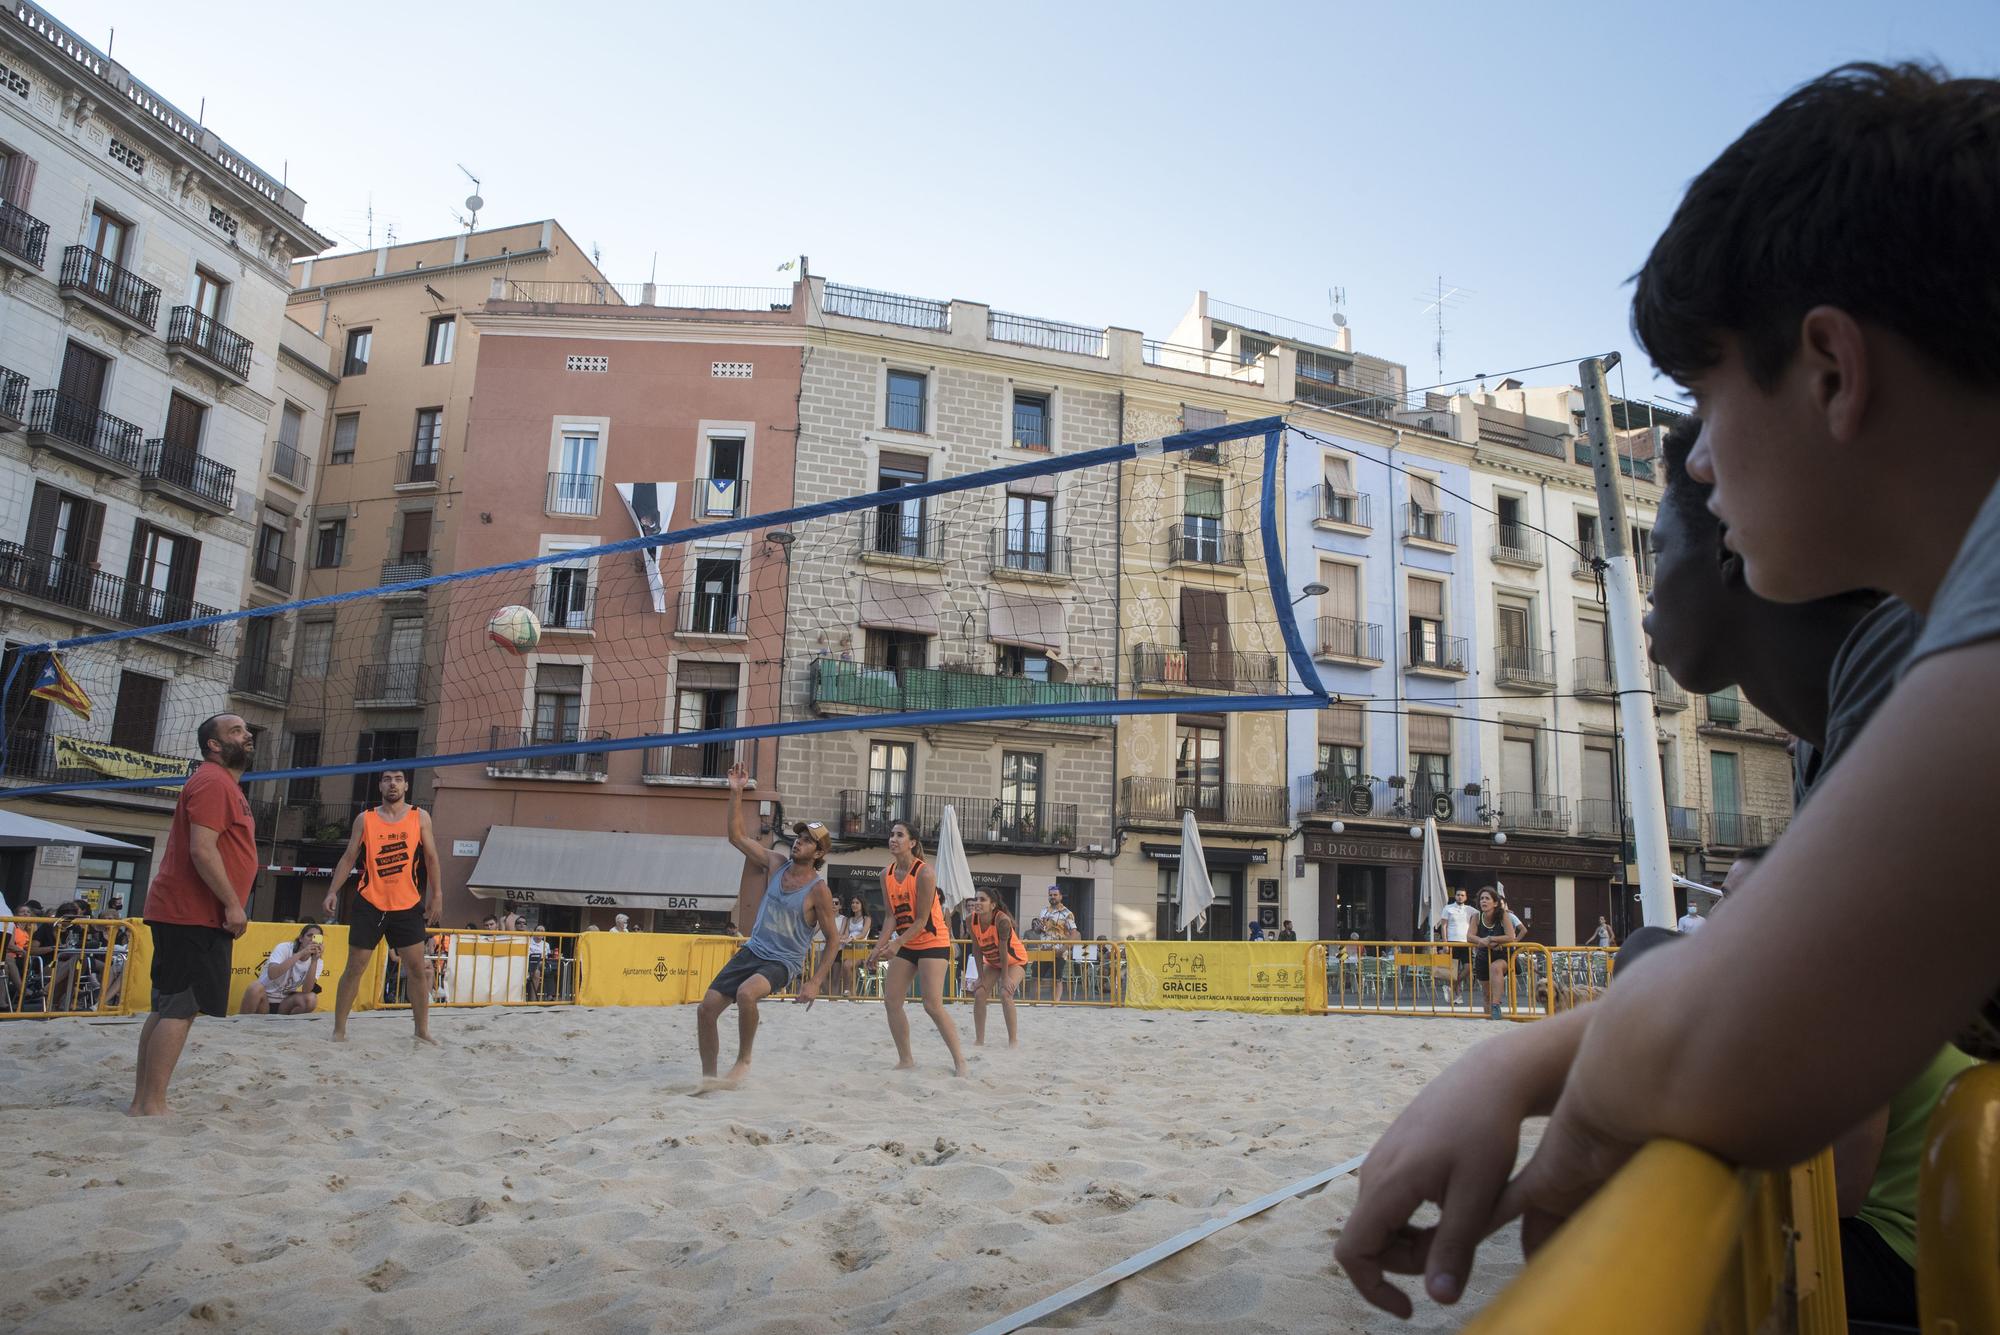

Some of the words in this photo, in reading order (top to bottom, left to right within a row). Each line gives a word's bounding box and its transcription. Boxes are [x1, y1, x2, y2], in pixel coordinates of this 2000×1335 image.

[80, 745, 122, 762] costat
[1328, 843, 1413, 860] DROGUERIA
[506, 890, 535, 901] BAR
[668, 897, 698, 909] BAR
[1162, 980, 1208, 992] GRÀCIES
